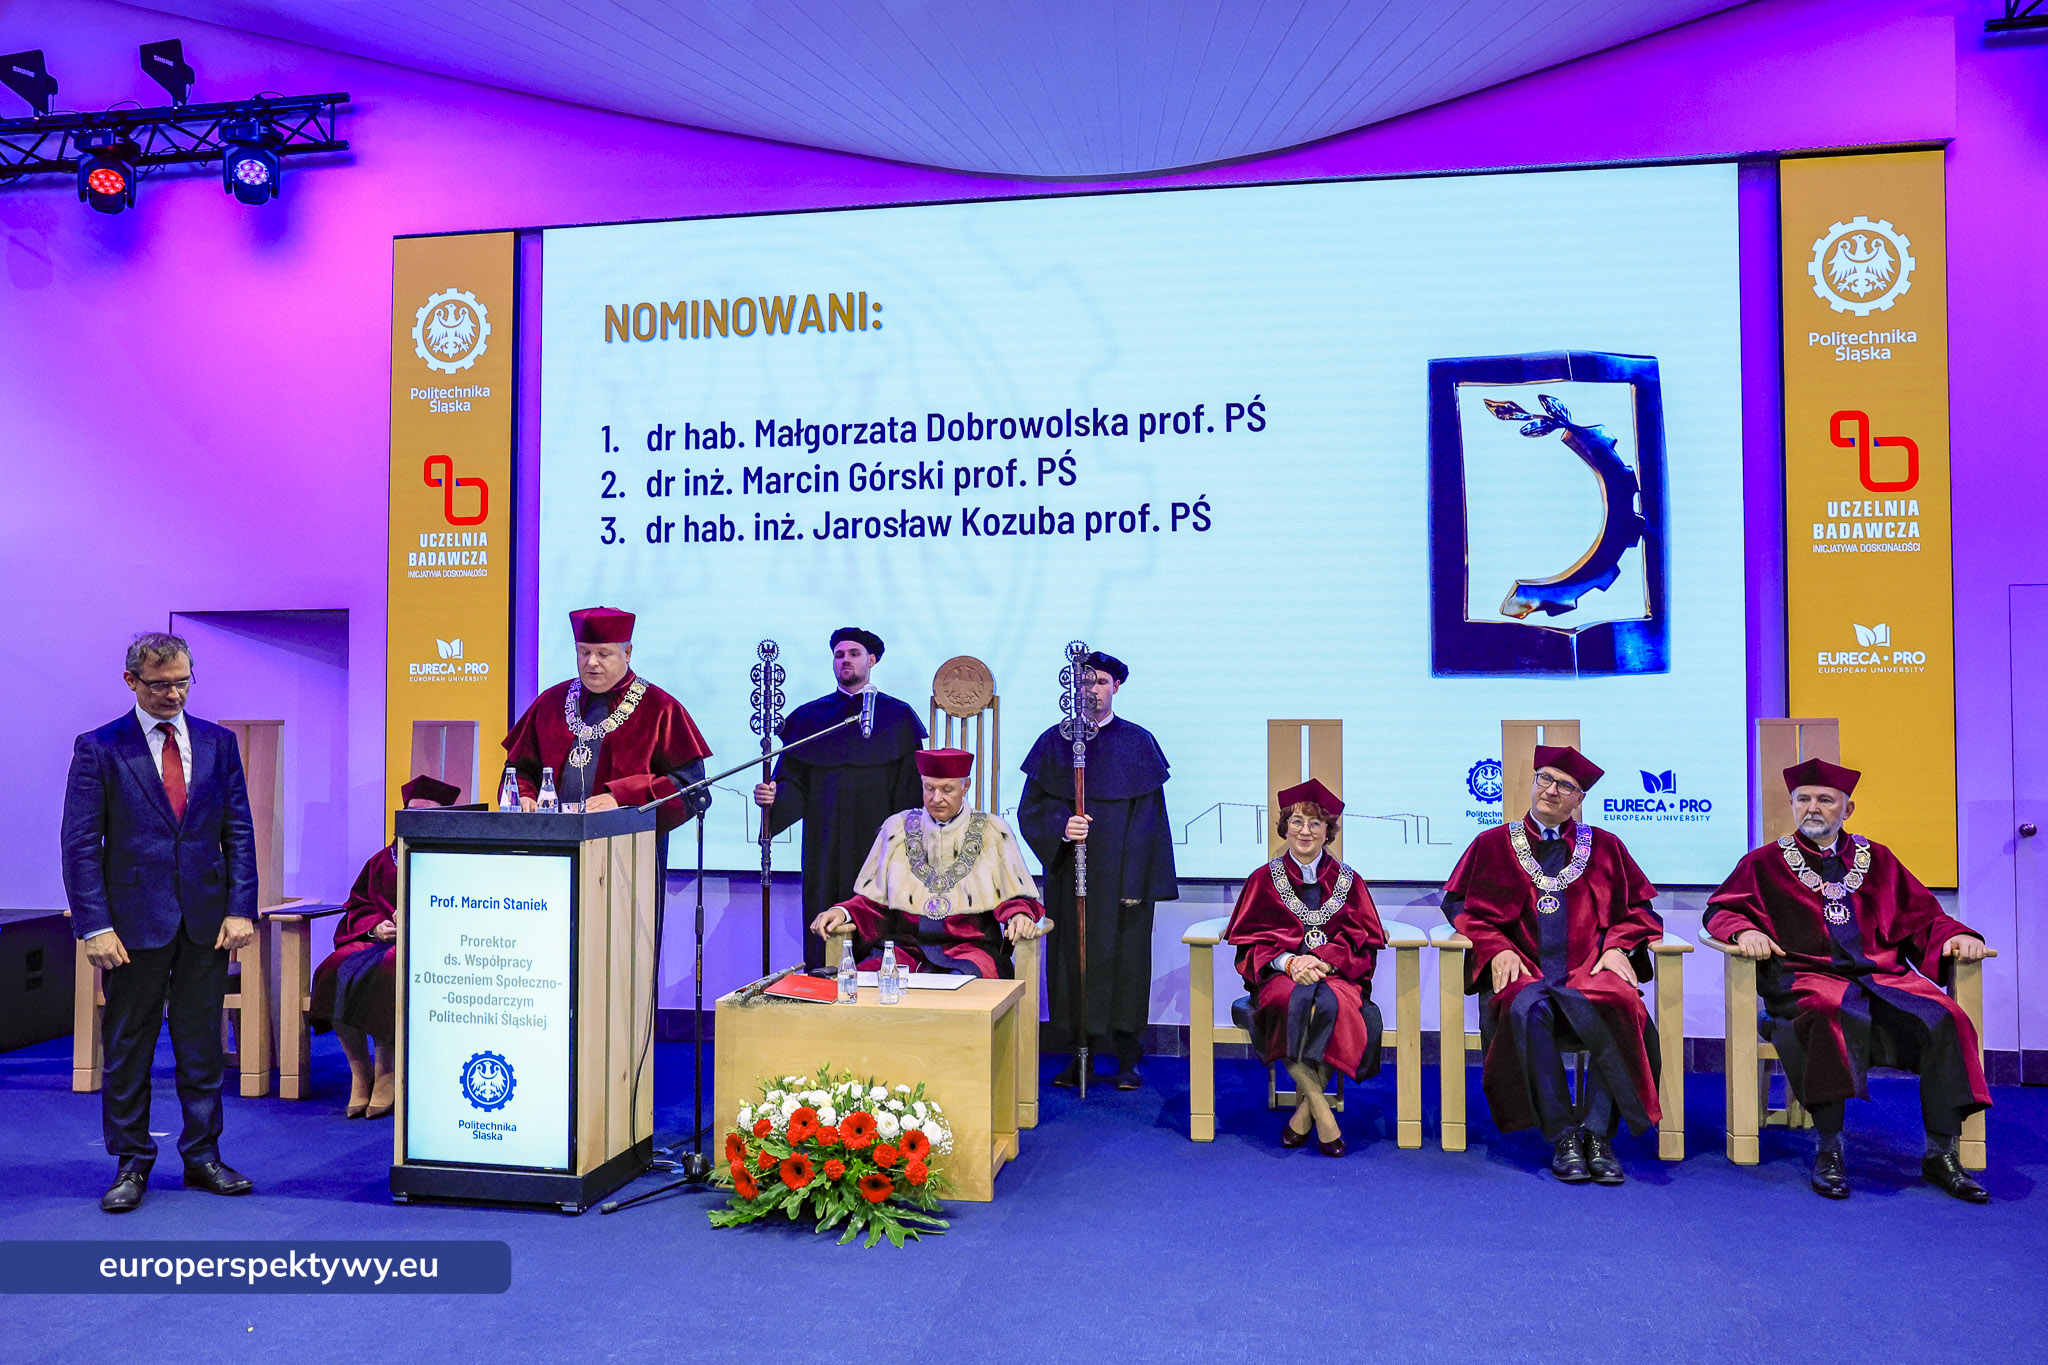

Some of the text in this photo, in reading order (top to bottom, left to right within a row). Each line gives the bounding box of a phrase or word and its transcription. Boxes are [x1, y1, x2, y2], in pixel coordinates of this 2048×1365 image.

[604, 291, 884, 343] NOMINOWANI:
[1808, 328, 1918, 347] Politechnika
[1835, 344, 1891, 362] Śląska
[410, 385, 491, 400] Politechnika
[429, 398, 471, 414] Śląska
[601, 394, 1267, 453] 1. dr hab. Małgorzata Dobrowolska prof. PŚ
[601, 449, 1078, 498] 2. dr inż. Marcin Górski prof. PŚ
[1827, 500, 1920, 517] UCZELNIA
[601, 494, 1212, 544] 3. dr hab. inż. Jarosław Kozuba prof. PŚ
[1812, 521, 1921, 539] BADAWCZA
[419, 532, 488, 548] UCZELNIA
[1812, 541, 1921, 553] INICJATYWA DOSKONAŁOŚCI
[408, 551, 488, 567] BADAWCZA
[407, 568, 488, 578] INICJATYWA DOSKONAŁOŚCI
[1817, 652, 1926, 665] EURECA PRO
[409, 663, 489, 675] EURECA PRO
[1604, 799, 1712, 812] EURECA PRO
[1465, 810, 1503, 818] Politechn
[430, 895, 548, 911] Prof. Marcin Staniek
[460, 934, 517, 949] Prorektor
[444, 953, 533, 971] ds. Współpracy
[414, 971, 563, 990] z Otoczeniem Społeczno-
[442, 991, 534, 1009] -Gospodarczym
[429, 1009, 547, 1030] Politechniki Śląskiej
[458, 1119, 517, 1132] Politechnika
[472, 1129, 503, 1141] Śląska
